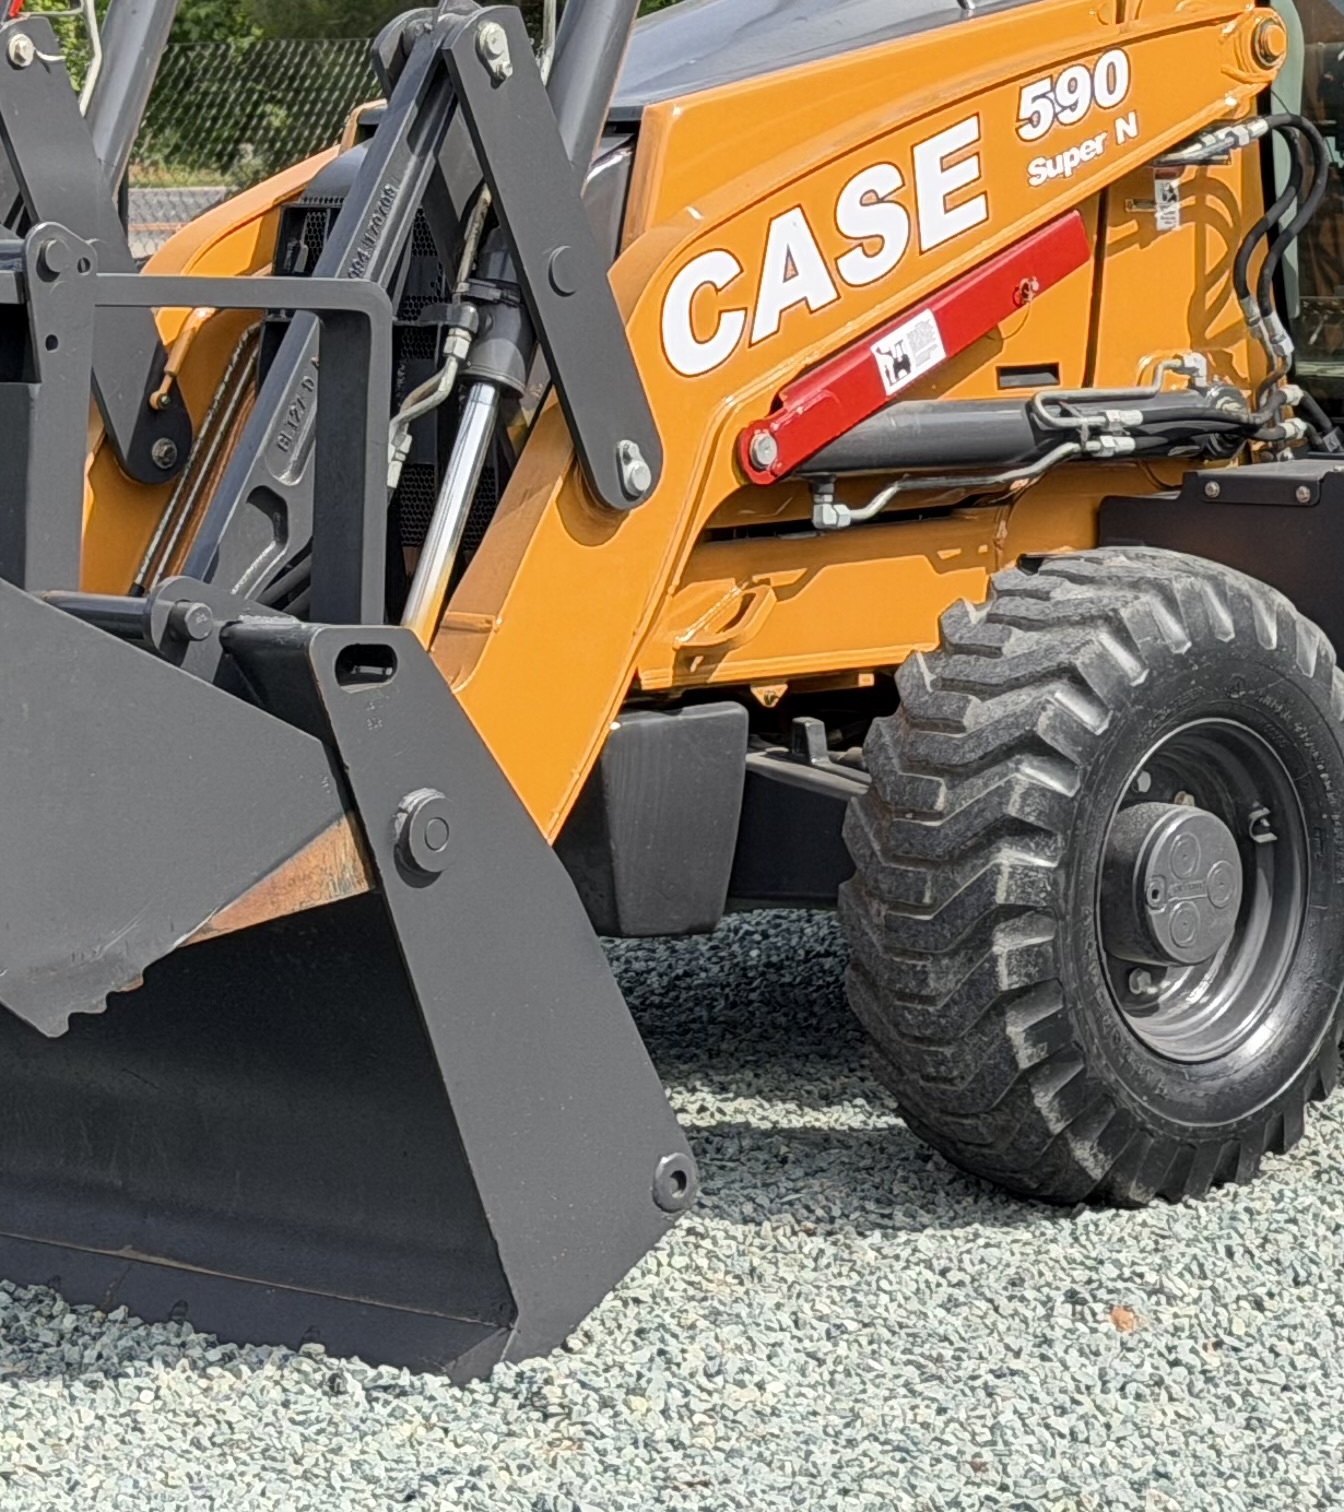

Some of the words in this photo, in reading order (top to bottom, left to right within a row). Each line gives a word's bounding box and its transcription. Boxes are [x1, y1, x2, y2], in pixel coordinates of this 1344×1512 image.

[1015, 47, 1132, 143] 590
[1027, 131, 1108, 187] Super
[1113, 109, 1139, 146] N
[659, 111, 990, 379] CASE
